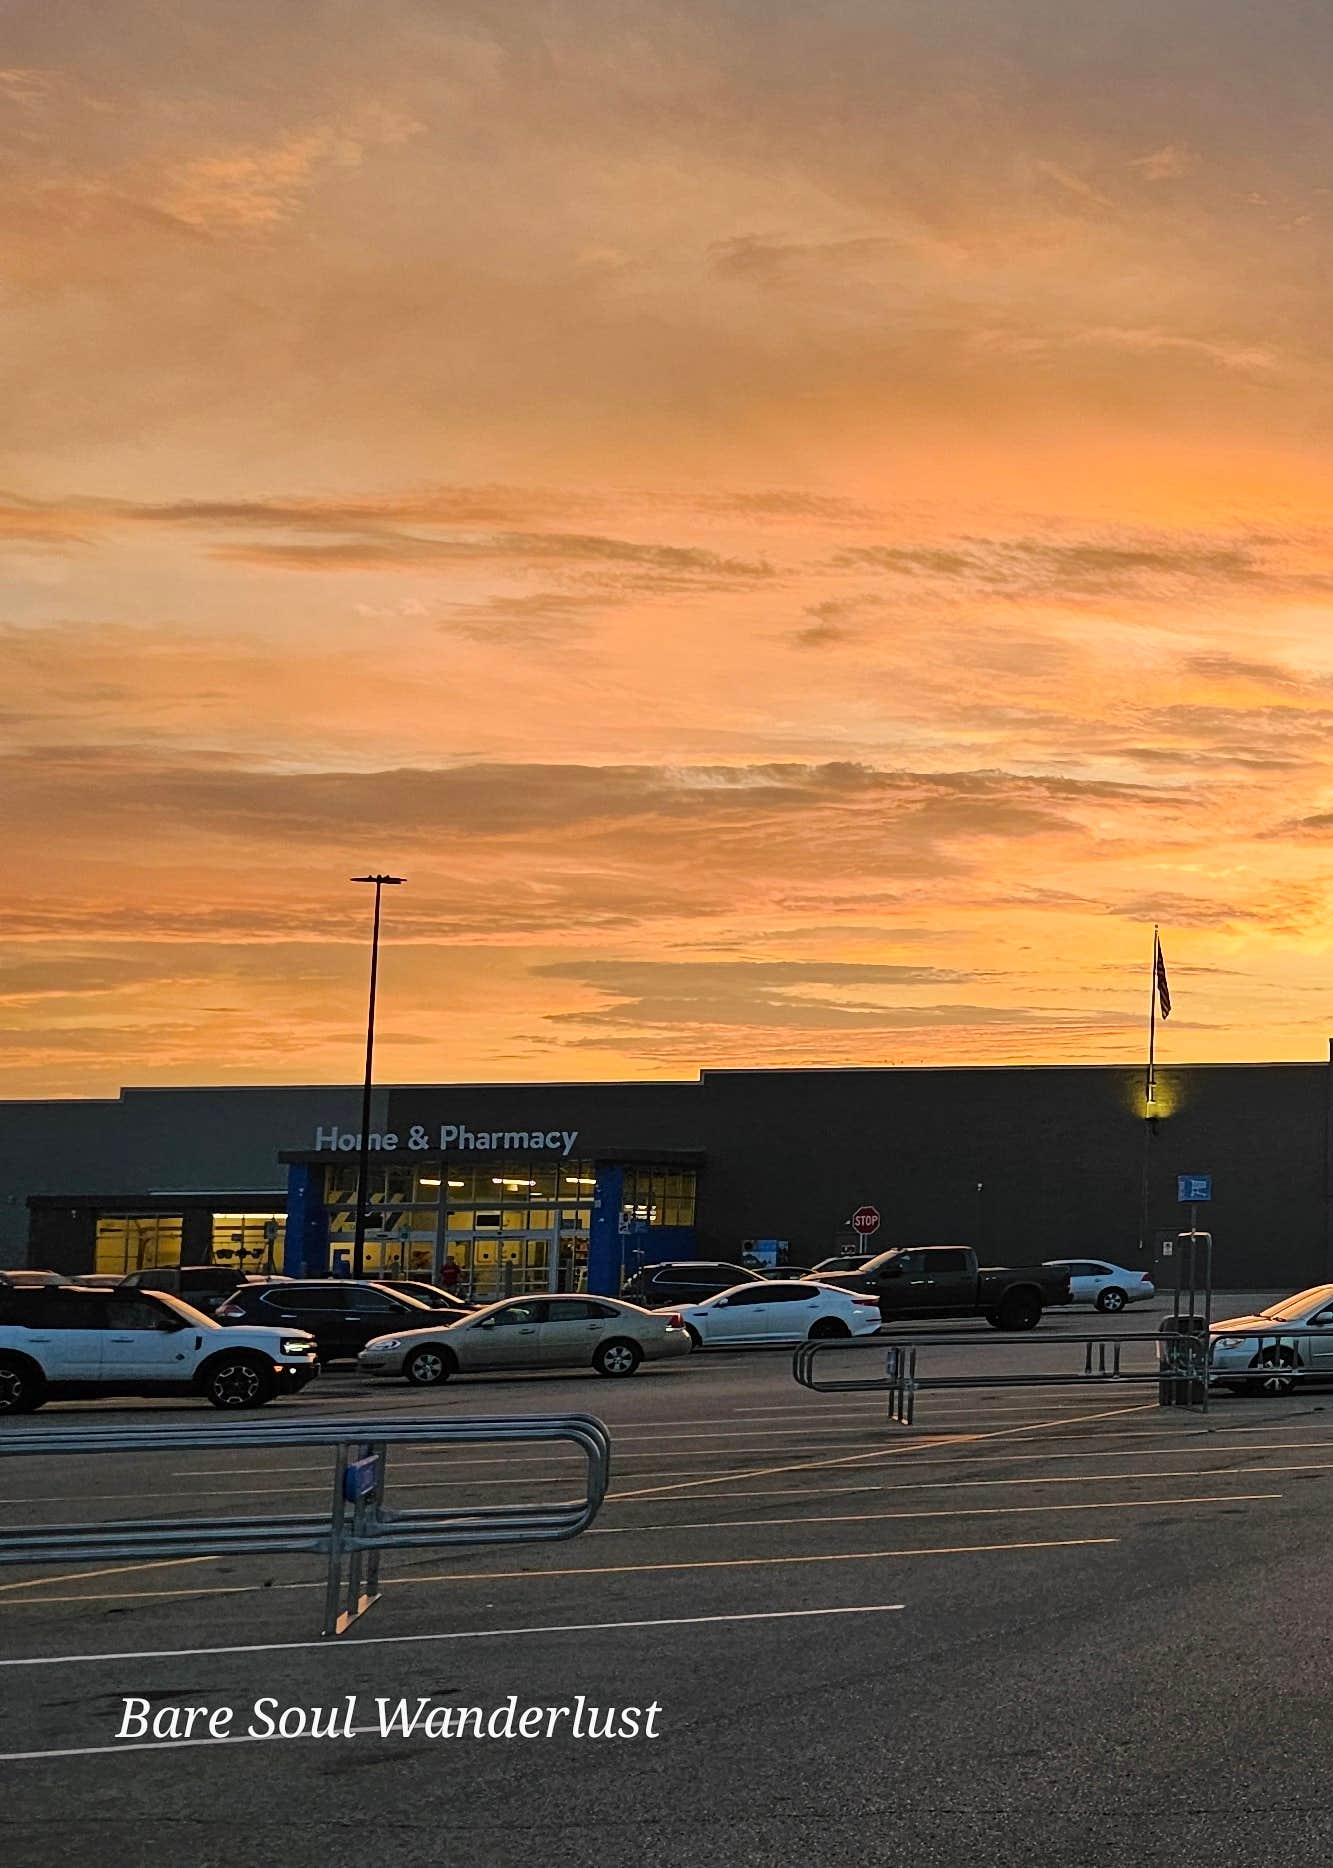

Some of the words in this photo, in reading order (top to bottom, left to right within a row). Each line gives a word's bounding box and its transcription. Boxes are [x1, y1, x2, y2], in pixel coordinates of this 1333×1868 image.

[316, 1126, 398, 1151] Home
[408, 1125, 430, 1151] &
[440, 1125, 578, 1156] Pharmacy
[854, 1215, 878, 1227] STOP
